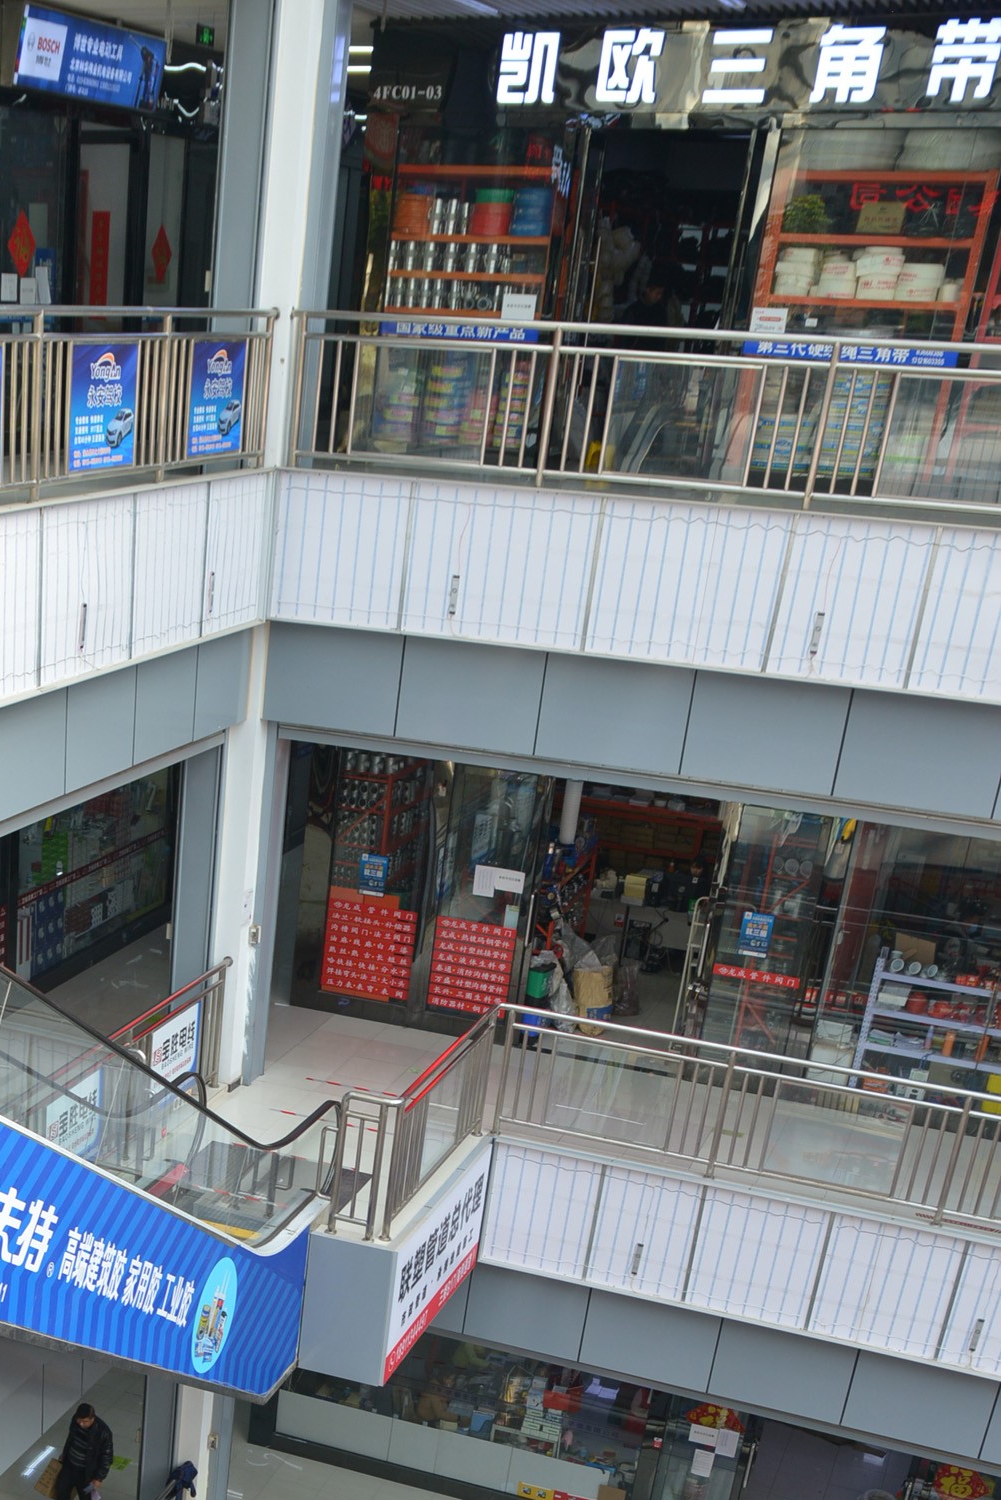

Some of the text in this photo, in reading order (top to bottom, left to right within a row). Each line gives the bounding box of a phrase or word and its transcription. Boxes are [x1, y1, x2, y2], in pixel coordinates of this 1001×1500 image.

[37, 36, 60, 54] BOSCH
[496, 19, 1001, 104] 凯欧三角带
[373, 85, 443, 100] 4FC01-03
[396, 322, 526, 341] 国家级重点新产品
[162, 1020, 195, 1062] 宝胜电线
[398, 1172, 486, 1304] 联塑管道总代理
[59, 1226, 197, 1328] 高端建筑胶 家用胶 工业胶
[941, 1466, 975, 1499] 福
